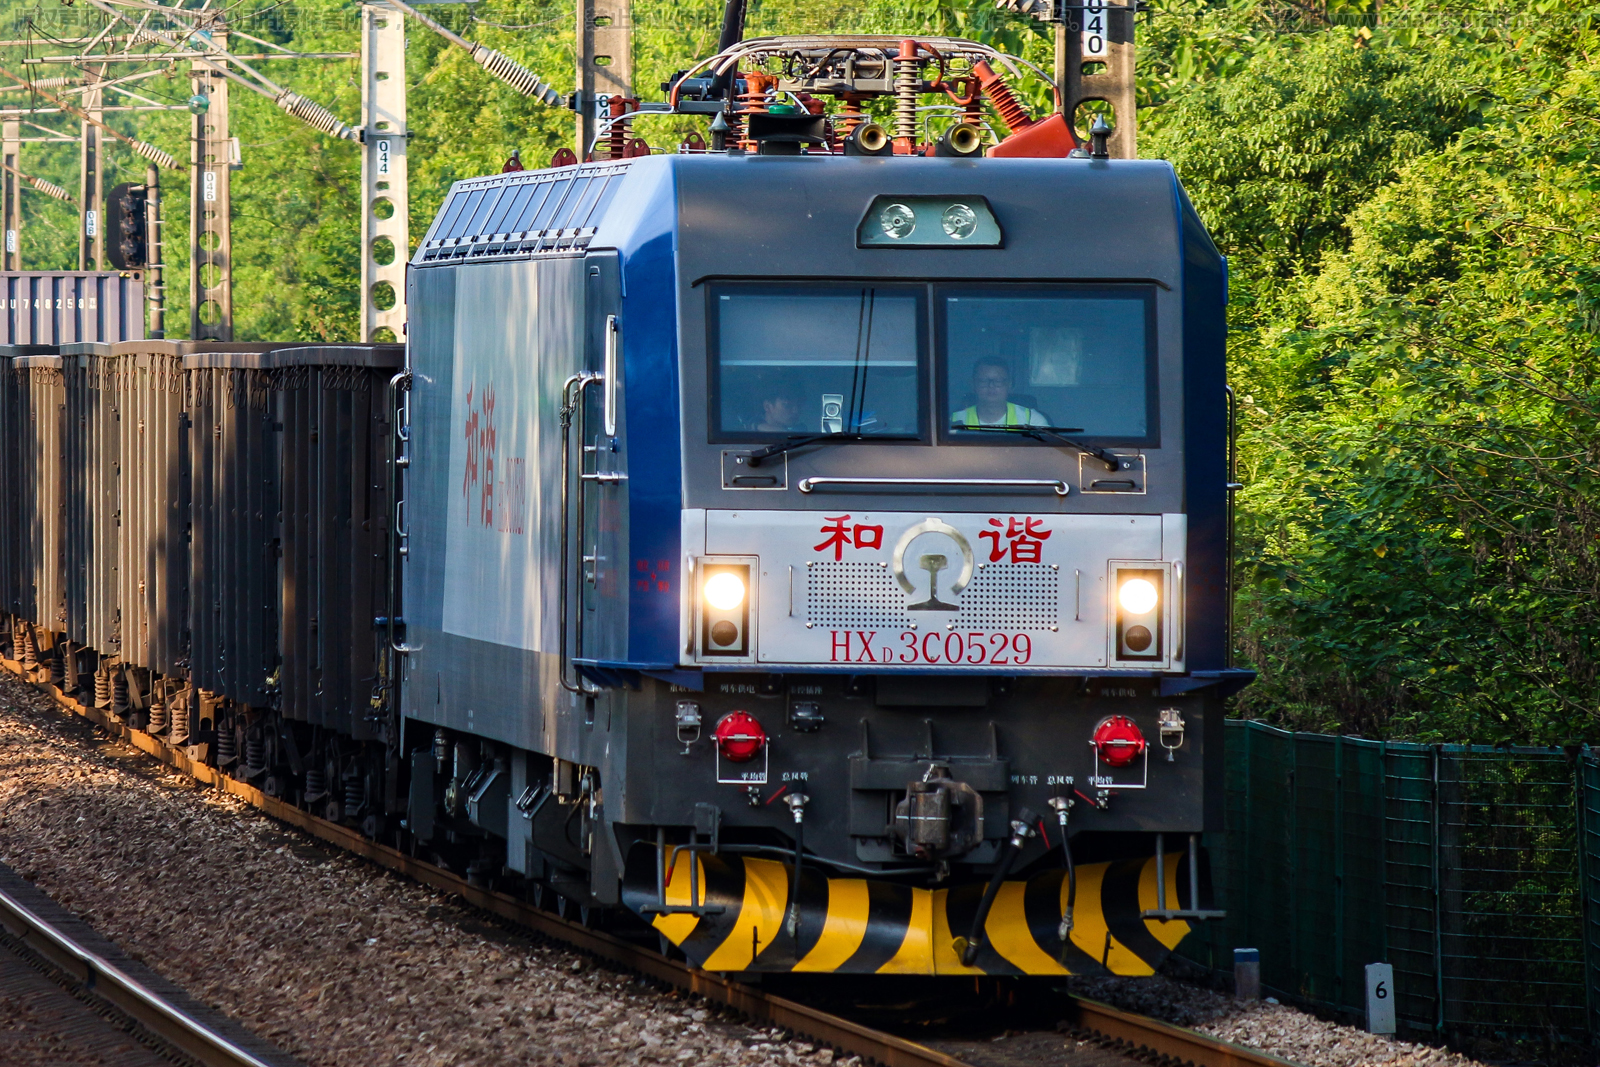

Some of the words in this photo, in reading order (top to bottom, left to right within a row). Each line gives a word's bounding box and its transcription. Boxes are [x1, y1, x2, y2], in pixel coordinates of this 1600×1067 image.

[379, 141, 389, 174] 044
[205, 172, 214, 200] 046
[87, 211, 95, 235] 048
[1375, 981, 1388, 999] 6
